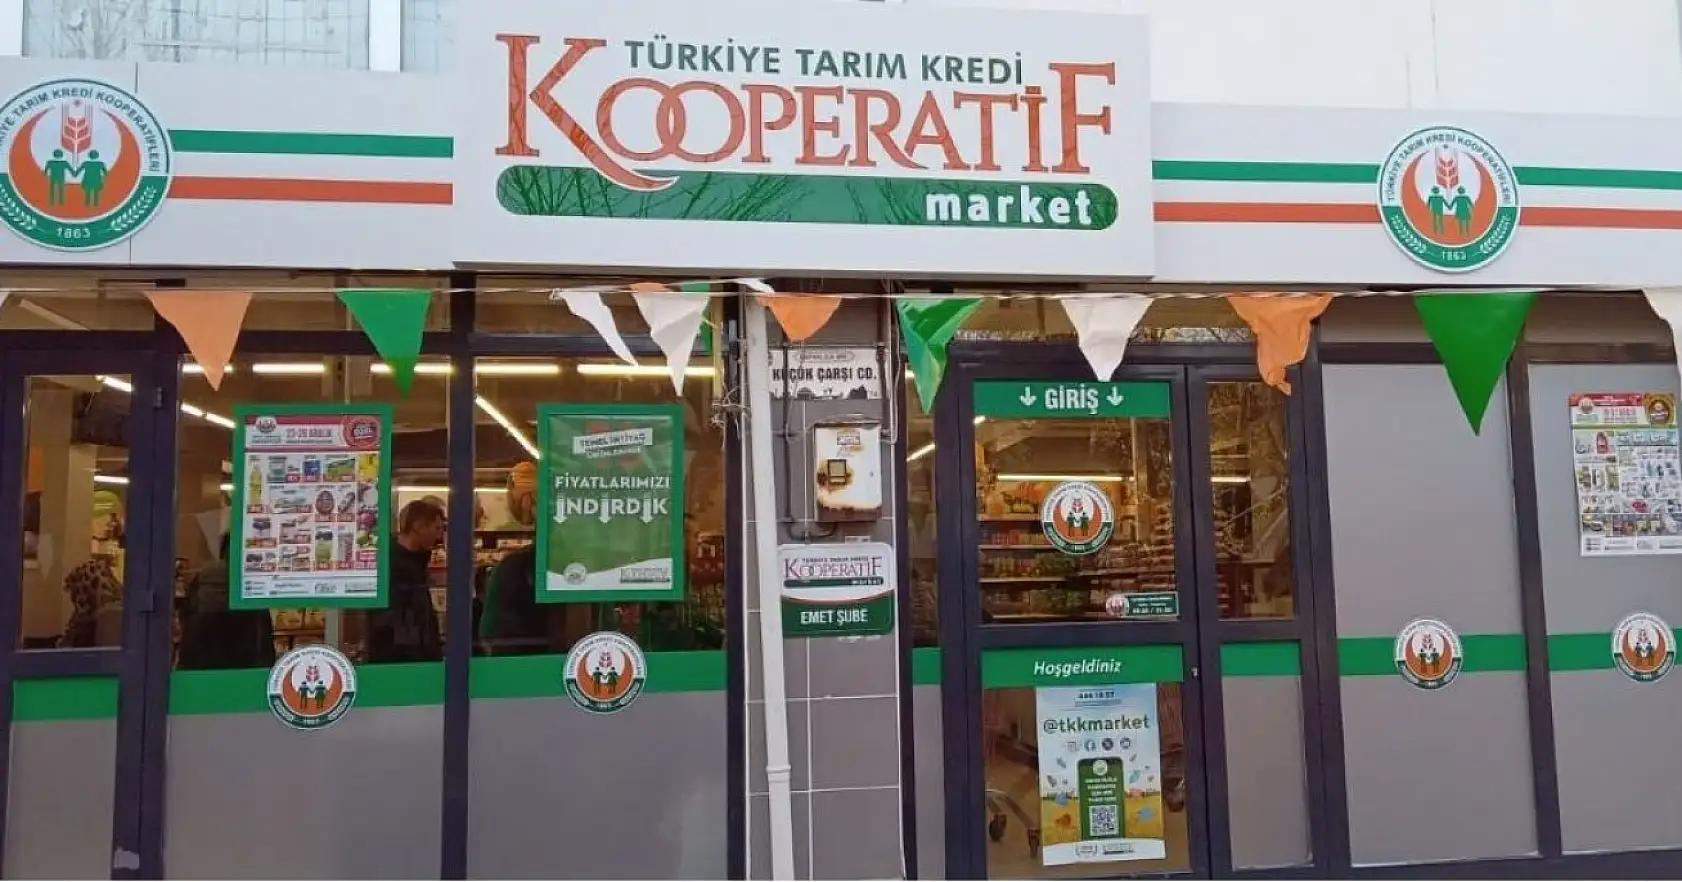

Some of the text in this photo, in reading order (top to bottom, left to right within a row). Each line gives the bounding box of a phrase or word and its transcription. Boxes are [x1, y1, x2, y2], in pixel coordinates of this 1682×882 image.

[624, 34, 1022, 85] TÜRKİYE TARIM KREDİ
[494, 32, 1116, 190] KOOPERATİF
[13, 91, 49, 118] TARIM
[52, 87, 94, 99] KREDİ
[96, 91, 161, 172] KOOPERATİFLERİ
[925, 184, 1092, 226] market
[56, 227, 91, 239] 1863
[817, 366, 853, 383] ÇARŞI
[1044, 384, 1099, 415] GİRİŞ
[555, 472, 670, 489] FİYATLARIMIZI
[800, 607, 868, 626] EMET ŞUBE
[1033, 658, 1123, 677] Hoşgeldiniz
[1043, 714, 1150, 734] @tkkmarket
